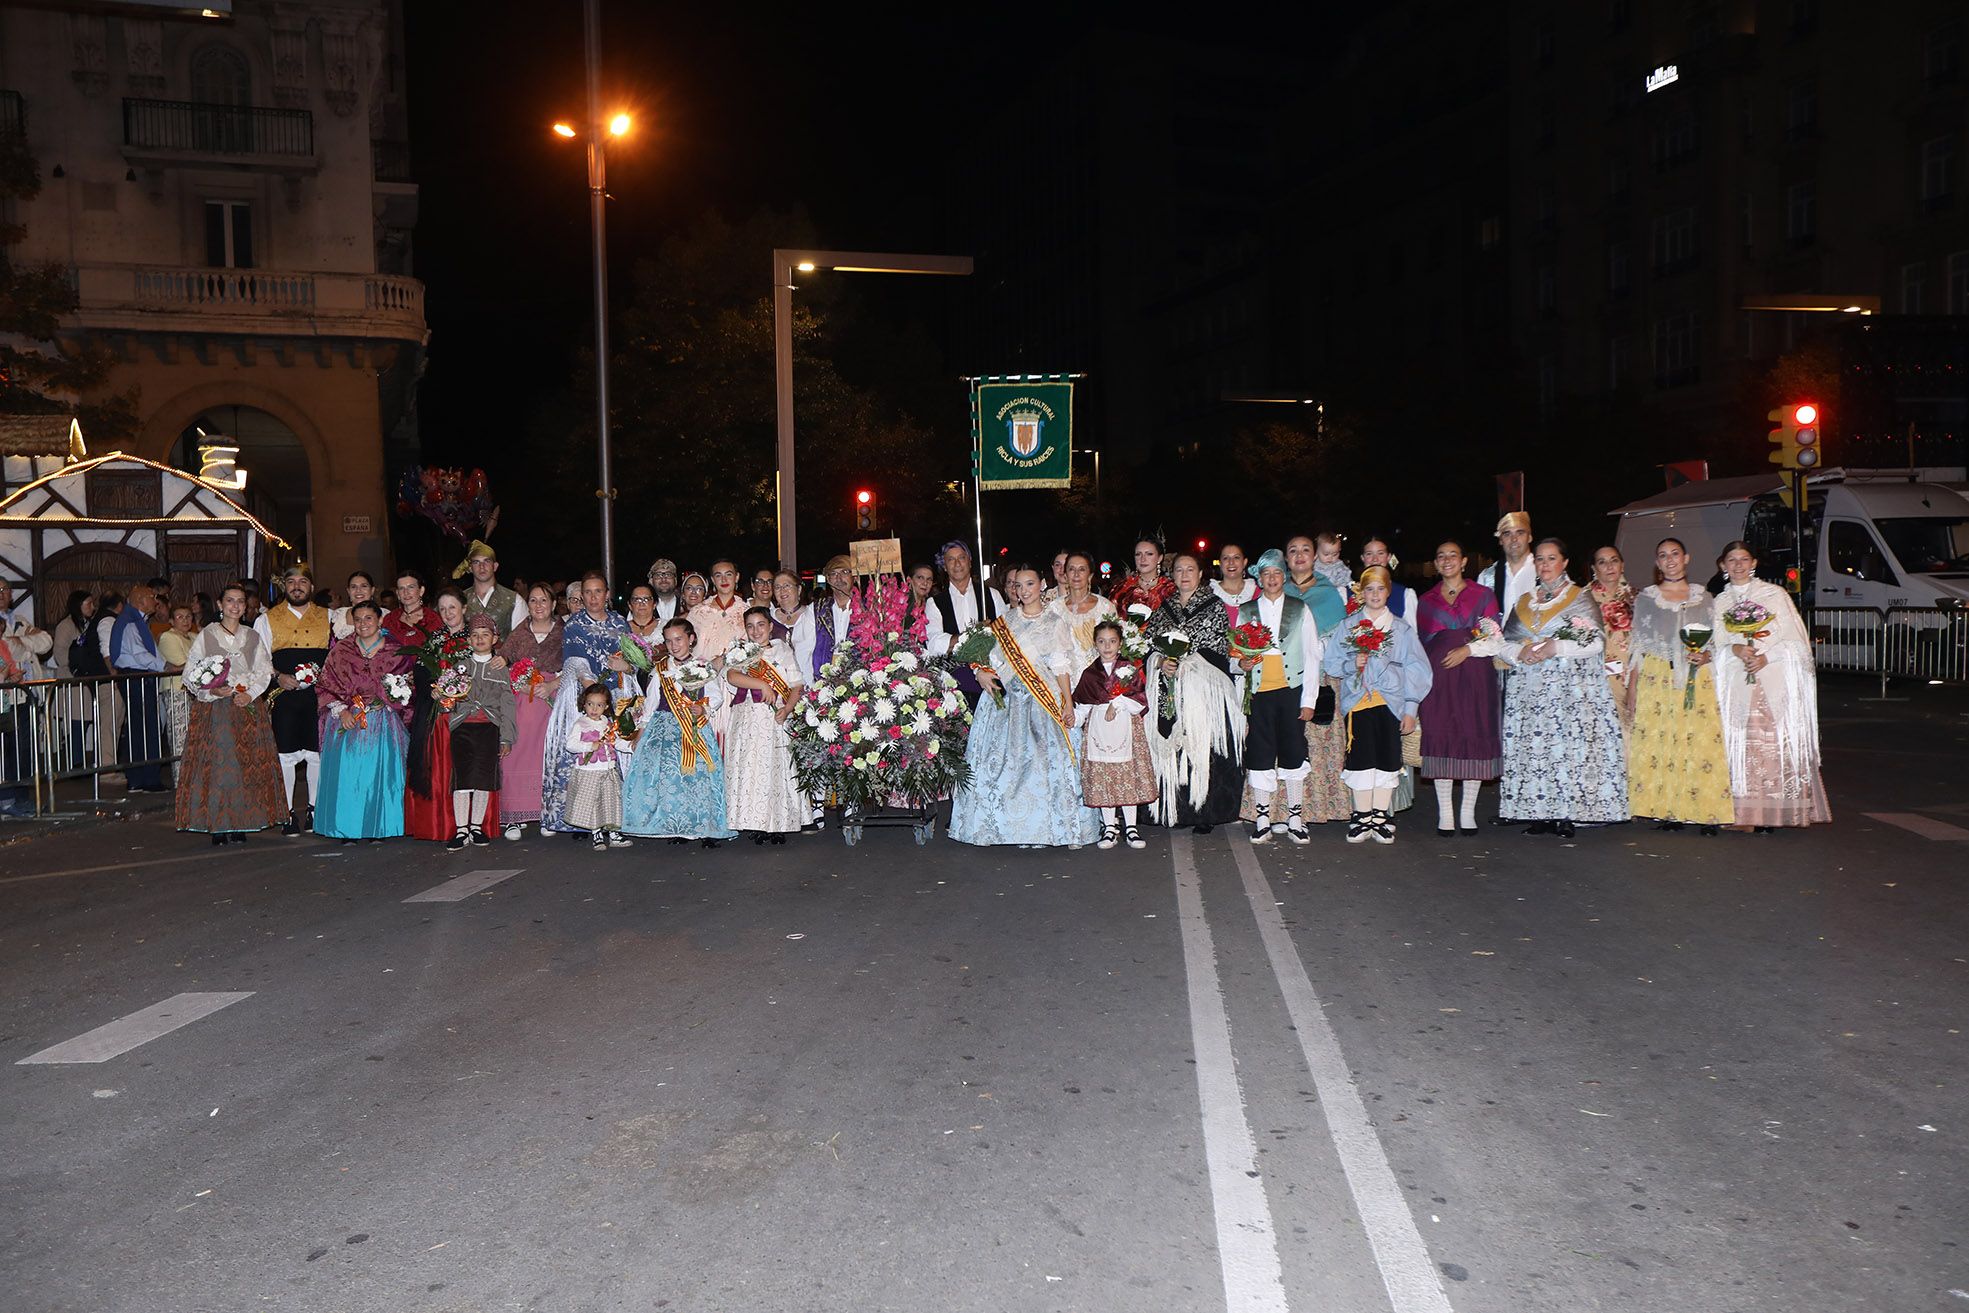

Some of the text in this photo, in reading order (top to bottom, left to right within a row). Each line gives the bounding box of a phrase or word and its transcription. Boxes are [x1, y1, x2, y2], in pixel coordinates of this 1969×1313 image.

[996, 397, 1055, 421] ASOCIACION CULTURAL
[996, 445, 1013, 465] RICLA
[1019, 460, 1033, 468] SUS
[1033, 445, 1055, 466] RAICES
[1888, 598, 1908, 606] UM07
